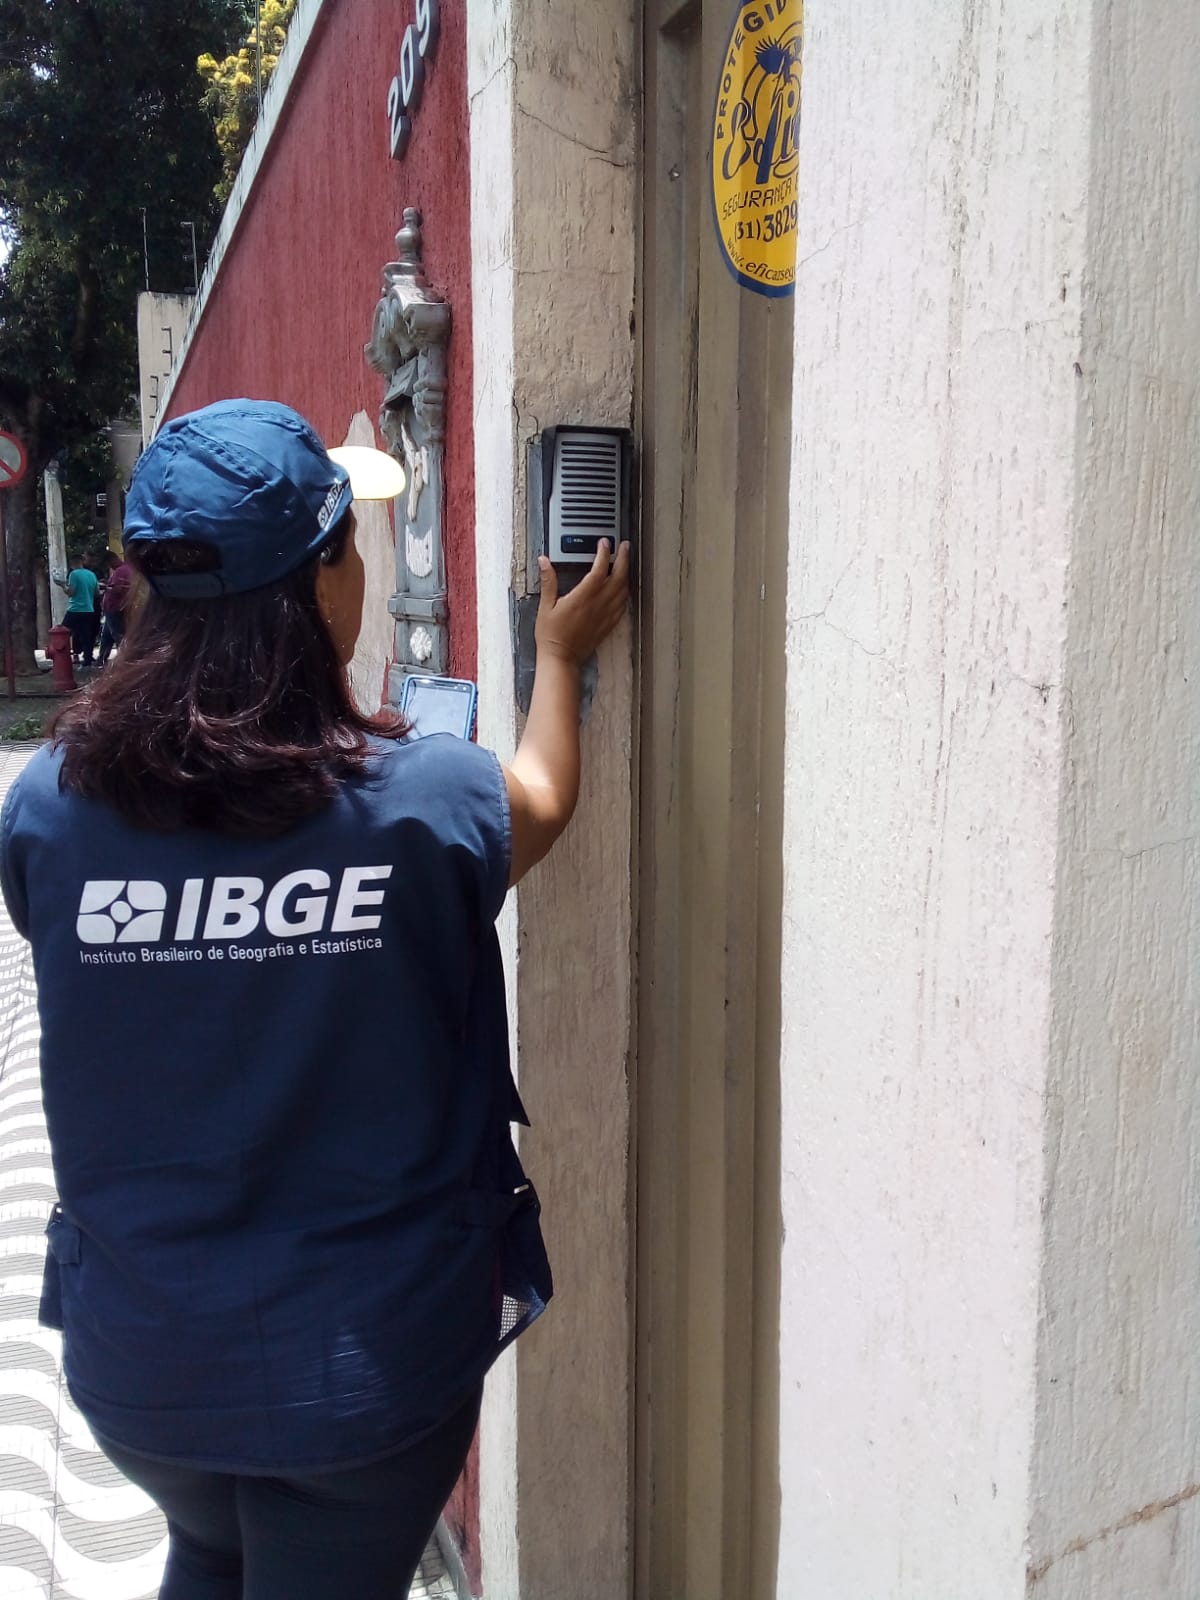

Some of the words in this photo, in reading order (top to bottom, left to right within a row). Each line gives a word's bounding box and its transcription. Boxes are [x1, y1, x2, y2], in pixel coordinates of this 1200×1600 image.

[735, 200, 798, 243] (31)3829
[174, 865, 393, 941] IBGE
[80, 950, 136, 964] Instituto
[141, 947, 203, 962] Brasileiro
[207, 946, 224, 960] de
[228, 943, 295, 962] Geografia
[299, 943, 308, 955] e
[311, 936, 383, 954] Estatística
